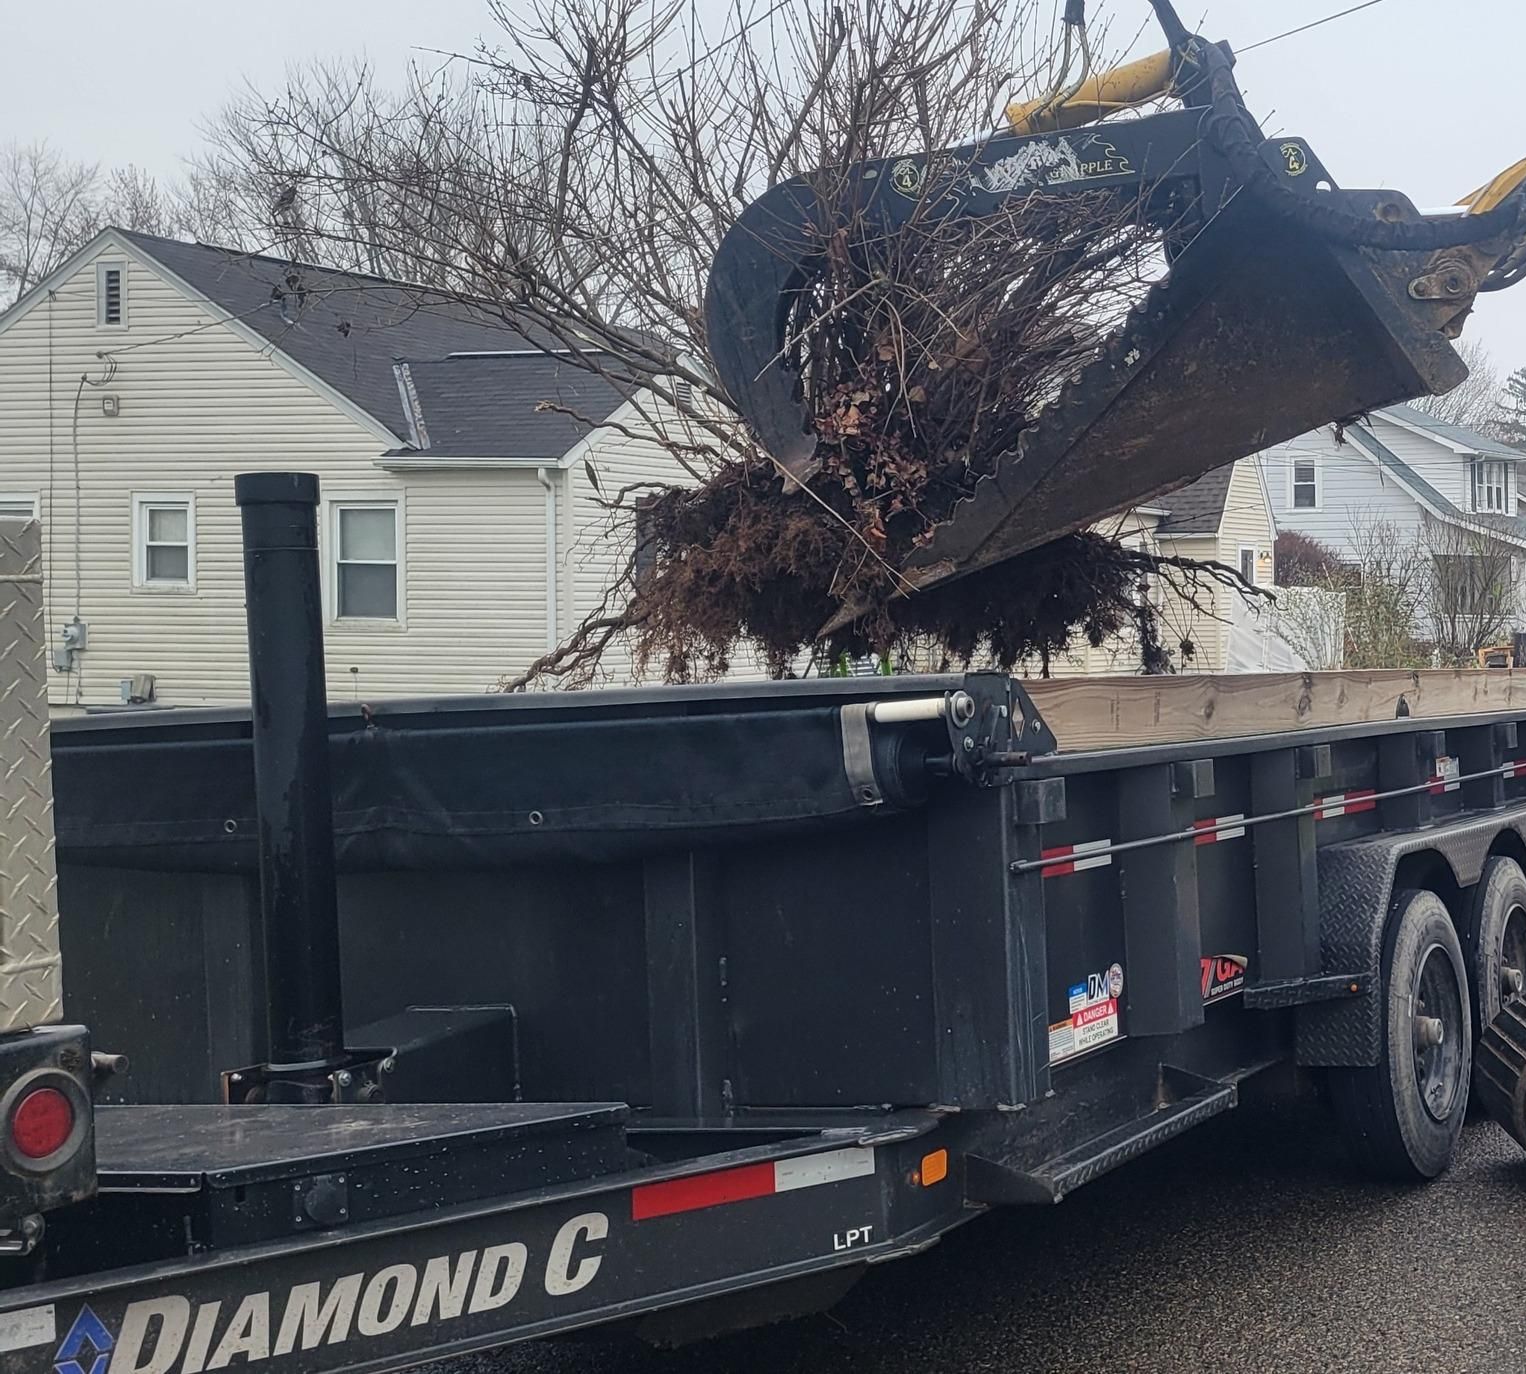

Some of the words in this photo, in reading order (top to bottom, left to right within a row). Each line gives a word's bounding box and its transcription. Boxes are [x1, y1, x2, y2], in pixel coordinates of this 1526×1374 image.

[1087, 969, 1110, 1001] DM
[1083, 1004, 1108, 1022] DANGER
[833, 1225, 873, 1250] LPT
[107, 1242, 526, 1374] DIAMOND
[544, 1211, 609, 1295] C
